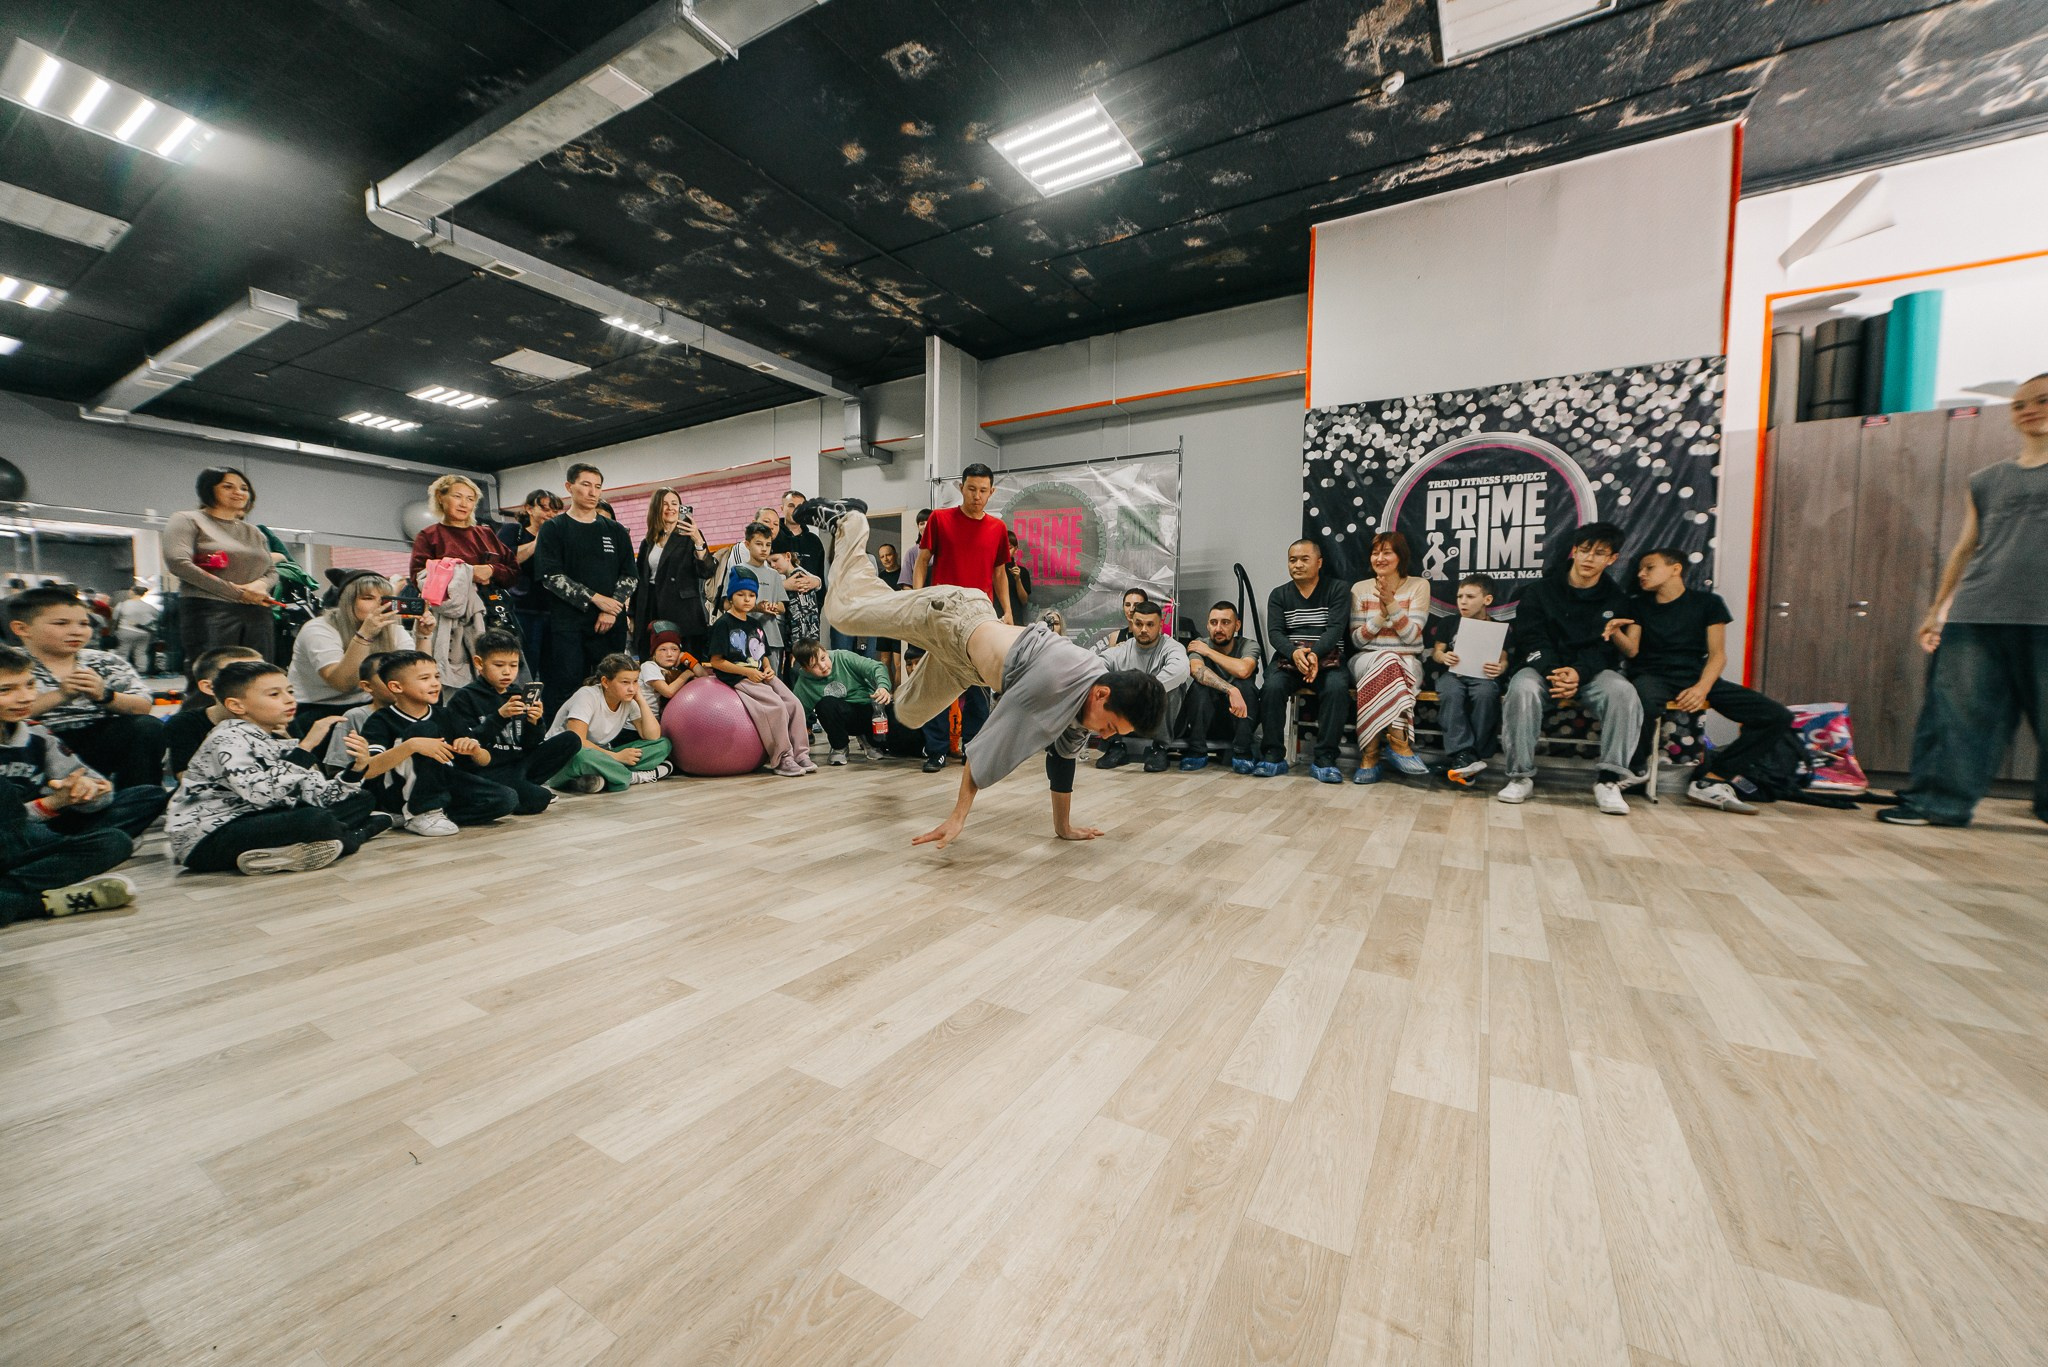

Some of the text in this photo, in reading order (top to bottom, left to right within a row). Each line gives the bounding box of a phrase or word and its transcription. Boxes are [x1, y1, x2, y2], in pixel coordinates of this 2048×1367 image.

[1428, 471, 1547, 489] TREND FITNESS PROJECT
[1454, 525, 1546, 571] TIME
[1476, 570, 1516, 579] AYER
[1517, 569, 1544, 579] N&A
